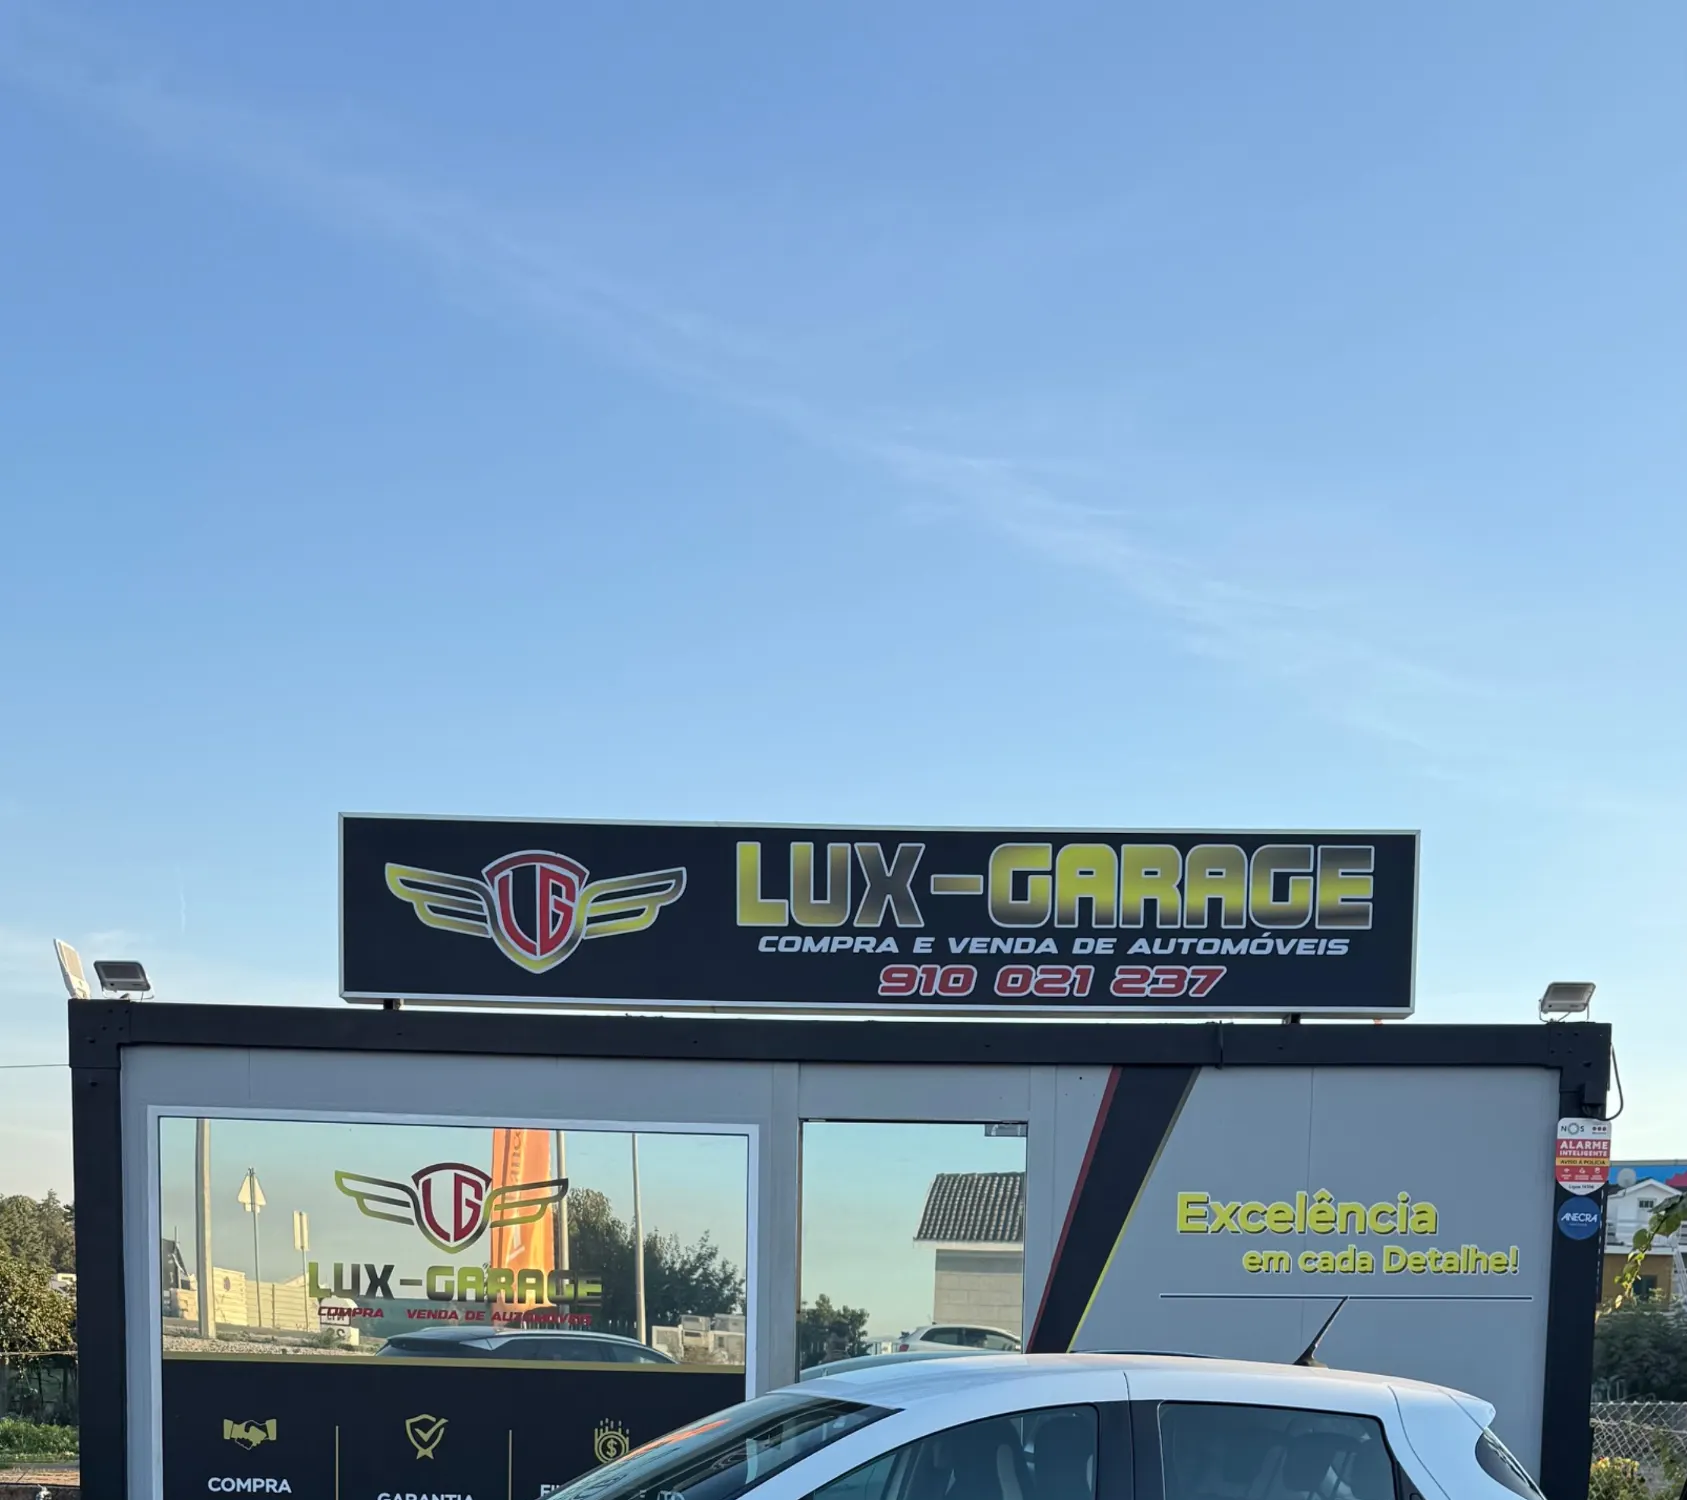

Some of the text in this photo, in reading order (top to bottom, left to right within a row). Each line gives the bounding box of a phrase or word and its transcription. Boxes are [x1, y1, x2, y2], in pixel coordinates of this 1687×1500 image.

[736, 841, 1375, 929] LUX-GARAGE
[758, 932, 1350, 955] COMPRA E VENDA DE AUTOMÓVEIS
[878, 964, 1227, 997] 910 021 237
[1560, 1122, 1585, 1135] NOS
[1560, 1141, 1608, 1149] ALARME
[1177, 1188, 1438, 1235] Excelência
[1561, 1213, 1598, 1222] ANECRA
[1242, 1244, 1520, 1276] em cada Detalhe!
[308, 1262, 602, 1304] LUX-GARAGE
[317, 1306, 384, 1318] COMPRA
[406, 1308, 459, 1321] VENDA
[465, 1310, 486, 1321] DE
[207, 1477, 292, 1493] COMPRA
